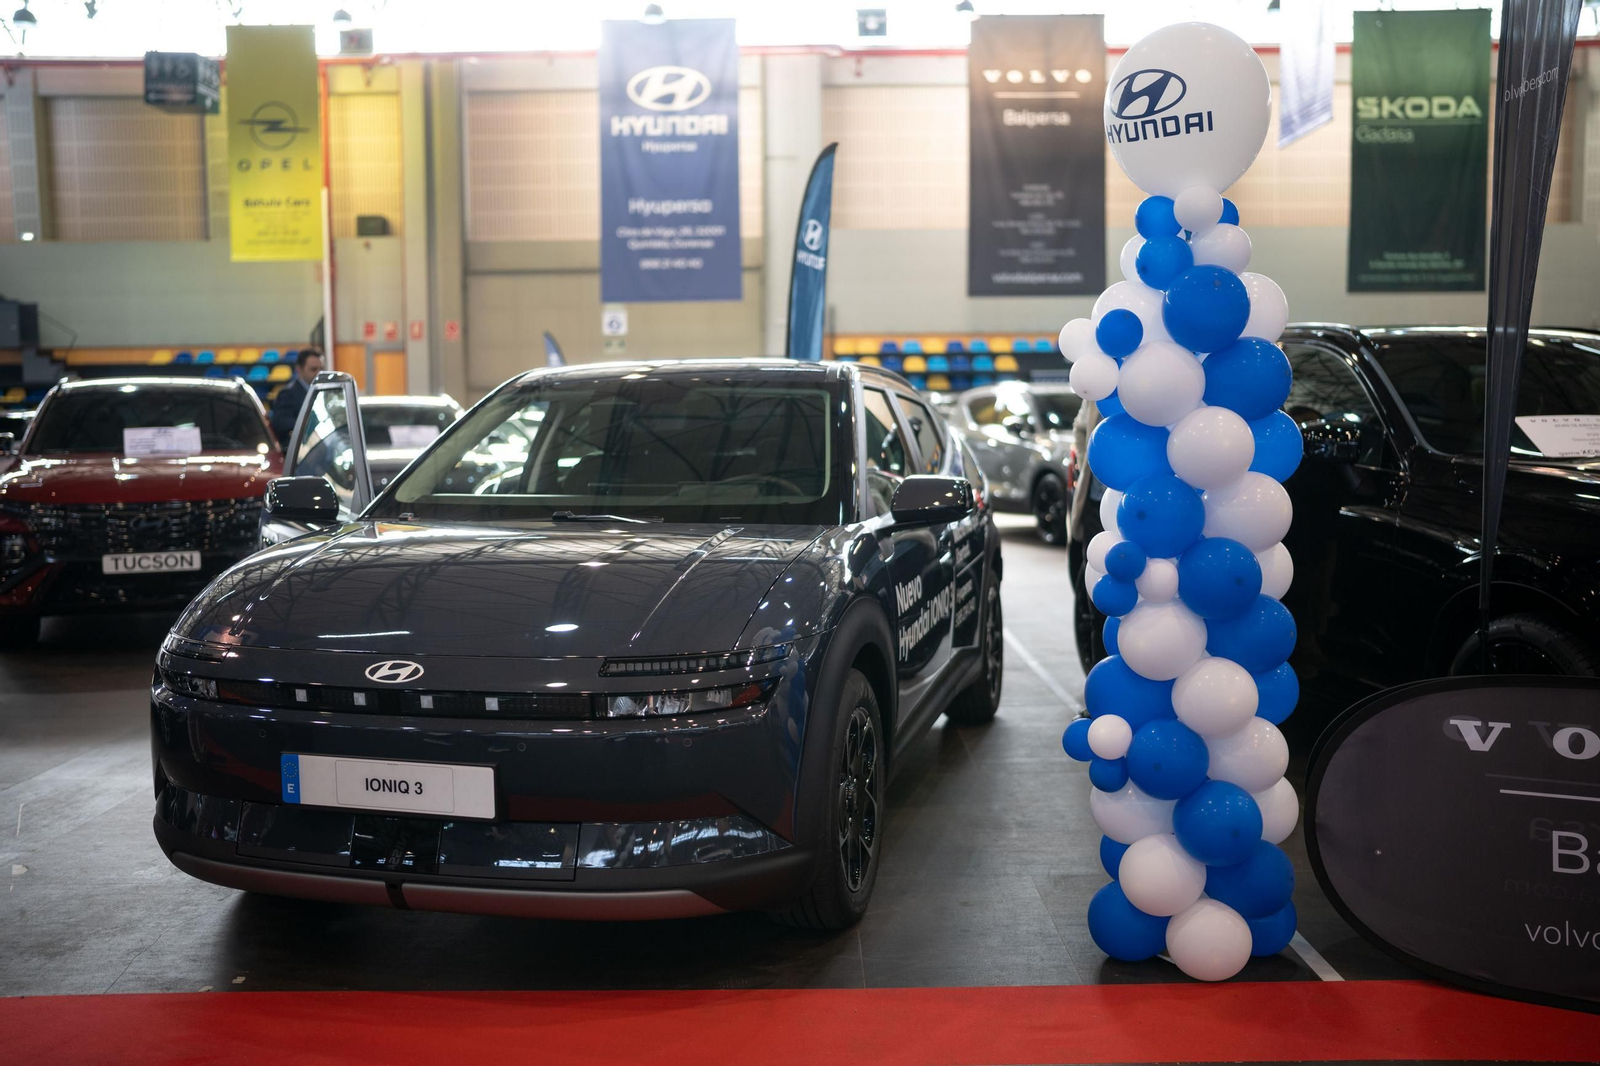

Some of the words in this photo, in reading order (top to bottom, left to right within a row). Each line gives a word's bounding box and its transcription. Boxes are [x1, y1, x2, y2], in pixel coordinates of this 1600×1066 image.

[982, 69, 1092, 83] VOLVO
[610, 113, 729, 137] HYUNDAI
[1003, 108, 1071, 129] Balpersa
[1106, 111, 1213, 144] HYUNDAI
[236, 157, 314, 173] OPEL
[111, 553, 194, 570] TUCSON
[895, 574, 922, 617] Nuevo
[898, 600, 930, 662] Hyundai
[930, 585, 950, 629] IONIQ
[287, 783, 295, 794] E
[365, 777, 410, 794] IONIQ
[414, 782, 423, 795] 3
[1553, 830, 1600, 875] B
